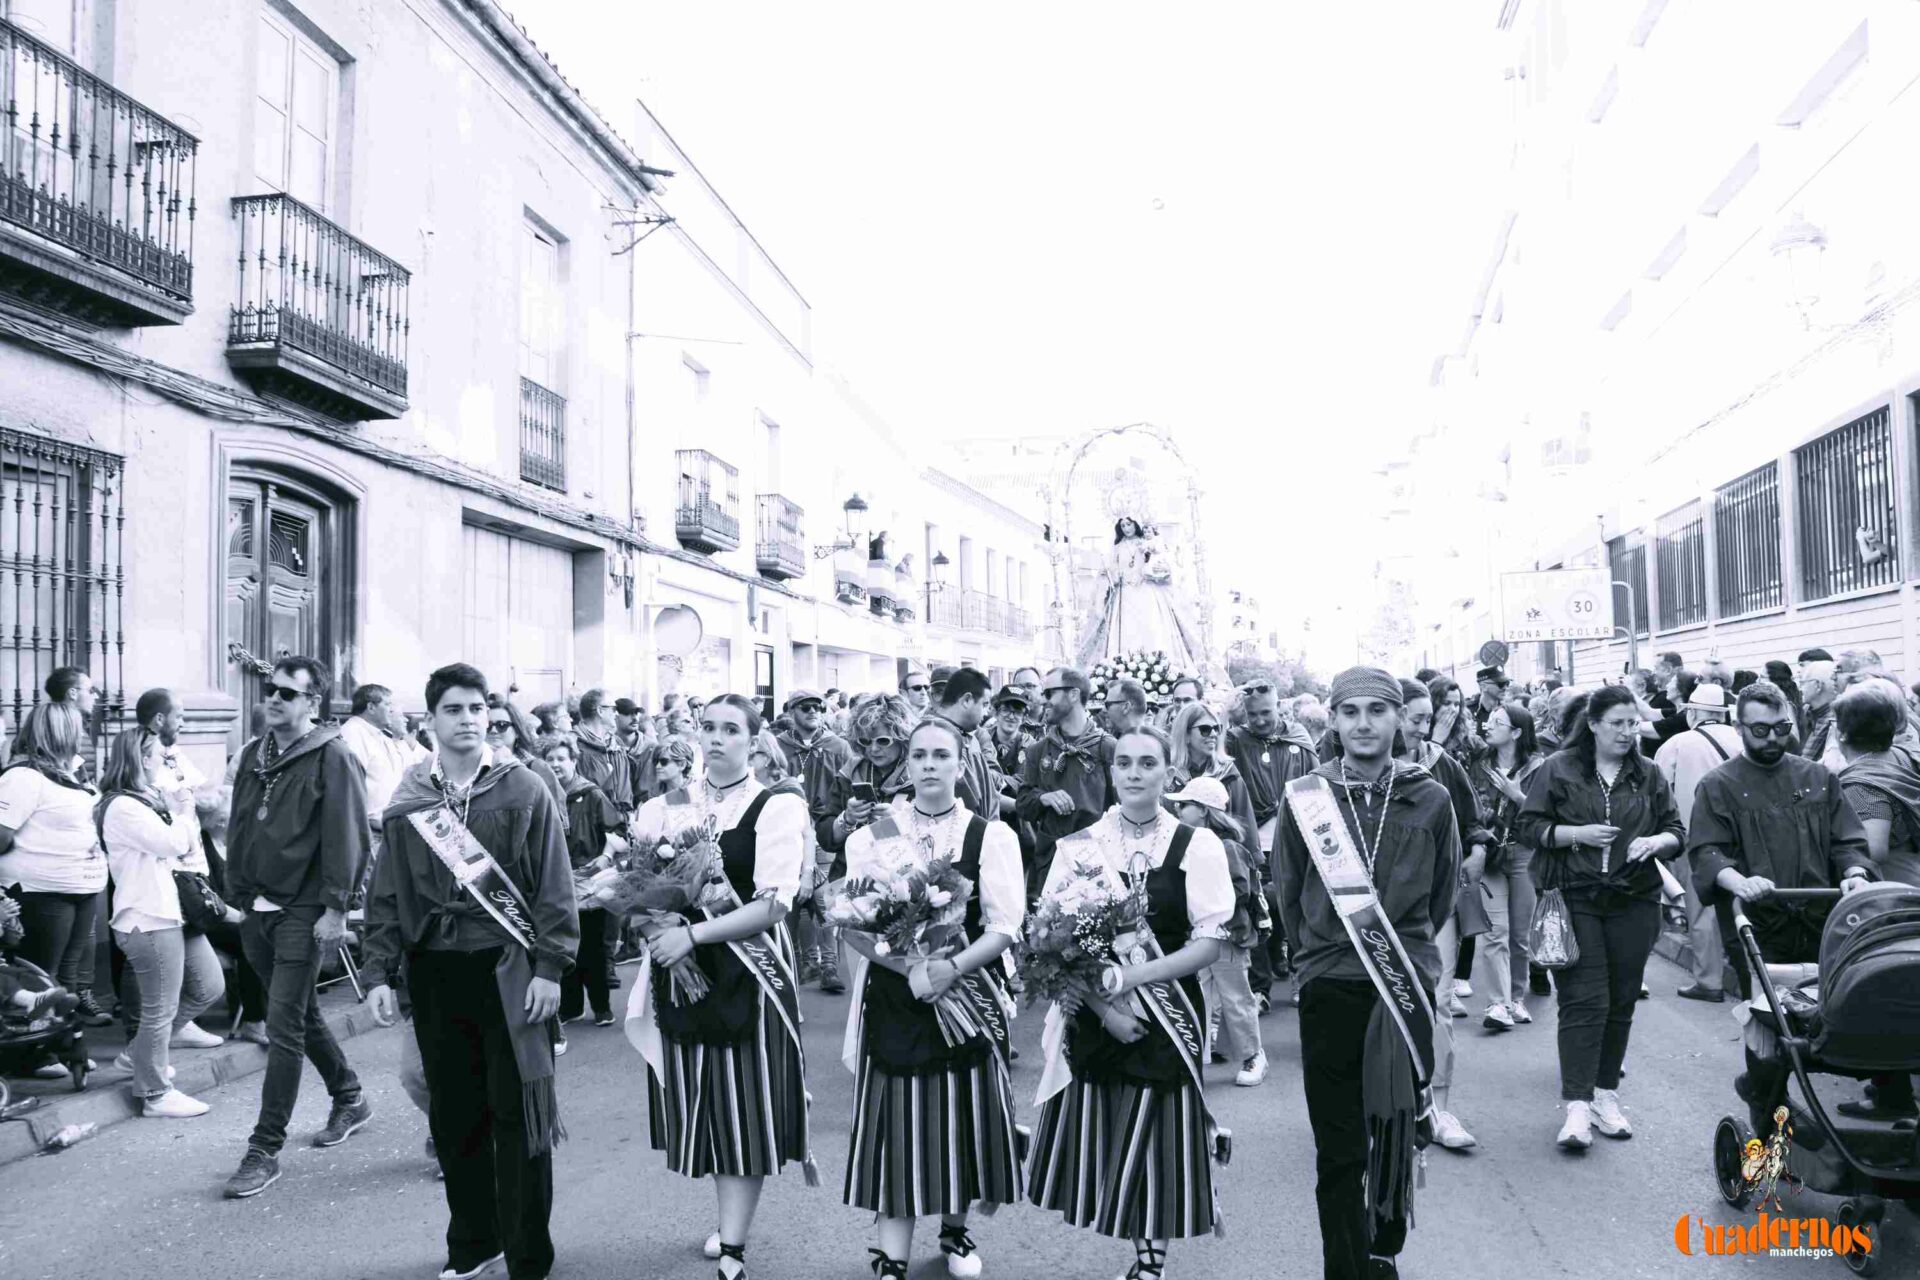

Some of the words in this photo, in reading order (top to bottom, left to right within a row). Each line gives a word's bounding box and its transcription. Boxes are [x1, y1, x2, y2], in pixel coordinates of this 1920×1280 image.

[1509, 629, 1542, 640] ZONA
[1551, 626, 1610, 637] ESCOLAR
[1574, 600, 1594, 613] 30
[742, 941, 784, 990] drina
[1361, 928, 1412, 1013] Padrino
[963, 972, 1006, 1041] adrina
[1149, 982, 1199, 1056] adrina
